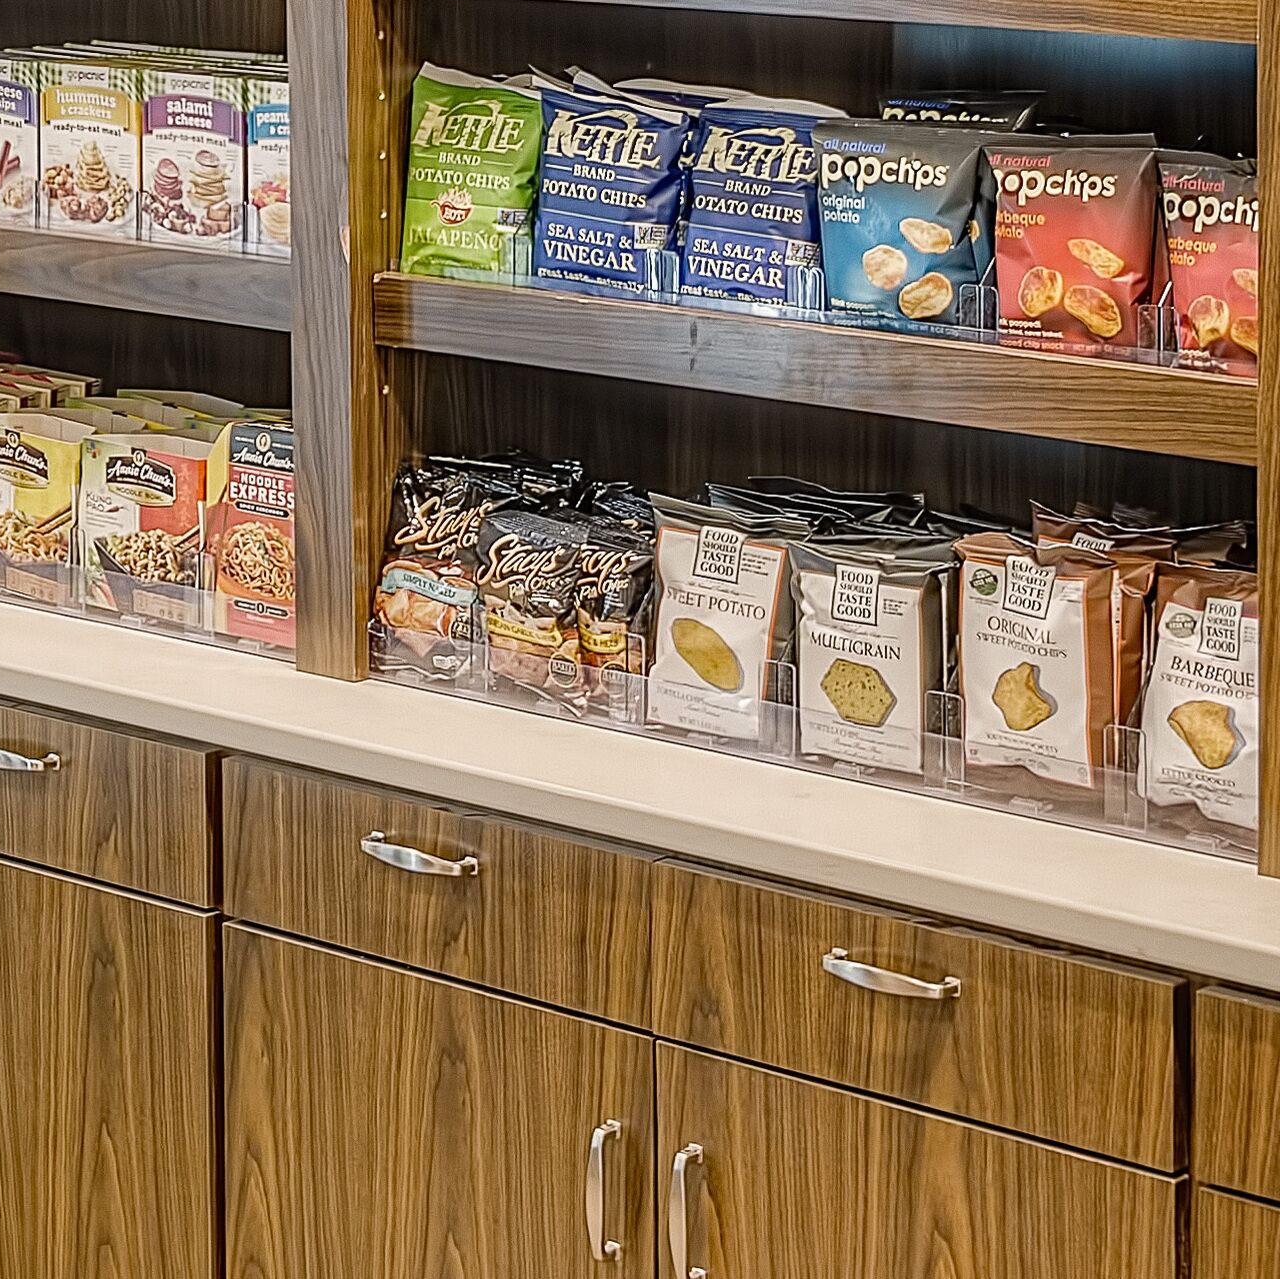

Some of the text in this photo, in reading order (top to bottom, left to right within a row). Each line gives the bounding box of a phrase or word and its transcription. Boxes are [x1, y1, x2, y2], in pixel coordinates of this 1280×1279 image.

[56, 89, 117, 108] hummus
[66, 106, 113, 119] crackers
[166, 98, 213, 117] salami
[4, 119, 23, 128] meal
[53, 123, 122, 137] ready-to-eat meal
[176, 115, 212, 129] cheese
[411, 100, 525, 154] KETTLE
[155, 133, 227, 147] ready-to-eat meal
[544, 108, 661, 169] KETTLE
[823, 139, 886, 153] all natural
[438, 152, 481, 166] BRAND
[693, 126, 818, 184] KETTLE
[1004, 156, 1050, 167] natural
[410, 167, 511, 190] POTATO CHIPS
[573, 164, 615, 181] BRAND
[822, 153, 947, 192] popchips
[542, 178, 648, 208] POTATO CHIPS
[724, 180, 771, 196] BRAND
[1180, 178, 1225, 192] natural
[822, 195, 866, 210] original
[751, 201, 804, 224] CHIPS
[823, 209, 860, 224] potato
[547, 222, 632, 248] SEA SALT &
[542, 240, 638, 272] VINEGAR
[692, 238, 783, 264] SEA SALT &
[687, 255, 786, 289] VINEGAR
[14, 445, 48, 470] Chun's
[233, 446, 262, 463] Annie
[107, 459, 174, 488] Annie Chun's
[240, 473, 285, 490] NOODLE
[229, 482, 294, 509] EXPRESS
[704, 530, 738, 544] FOOD
[702, 541, 737, 553] SHOULD
[701, 550, 735, 565] TASTE
[700, 562, 734, 576] GOOD
[841, 570, 874, 585] FOOD
[1011, 560, 1050, 578] FOOD
[839, 583, 873, 595] SHOULD
[1009, 582, 1045, 600] TASTE
[708, 596, 766, 620] POTATO
[837, 592, 872, 607] TASTE
[1008, 595, 1042, 612] GOOD
[836, 604, 871, 619] GOOD
[1208, 603, 1237, 617] FOOD
[1206, 616, 1236, 627] SHOULD
[987, 616, 1057, 646] ORIGINAL
[1206, 626, 1236, 641] TASTE
[809, 631, 901, 661] MULTIGRAIN
[975, 632, 1006, 648] SWEET
[1206, 638, 1236, 654] GOOD
[1171, 656, 1255, 688] BARBEQUE
[1159, 673, 1194, 690] SWEET
